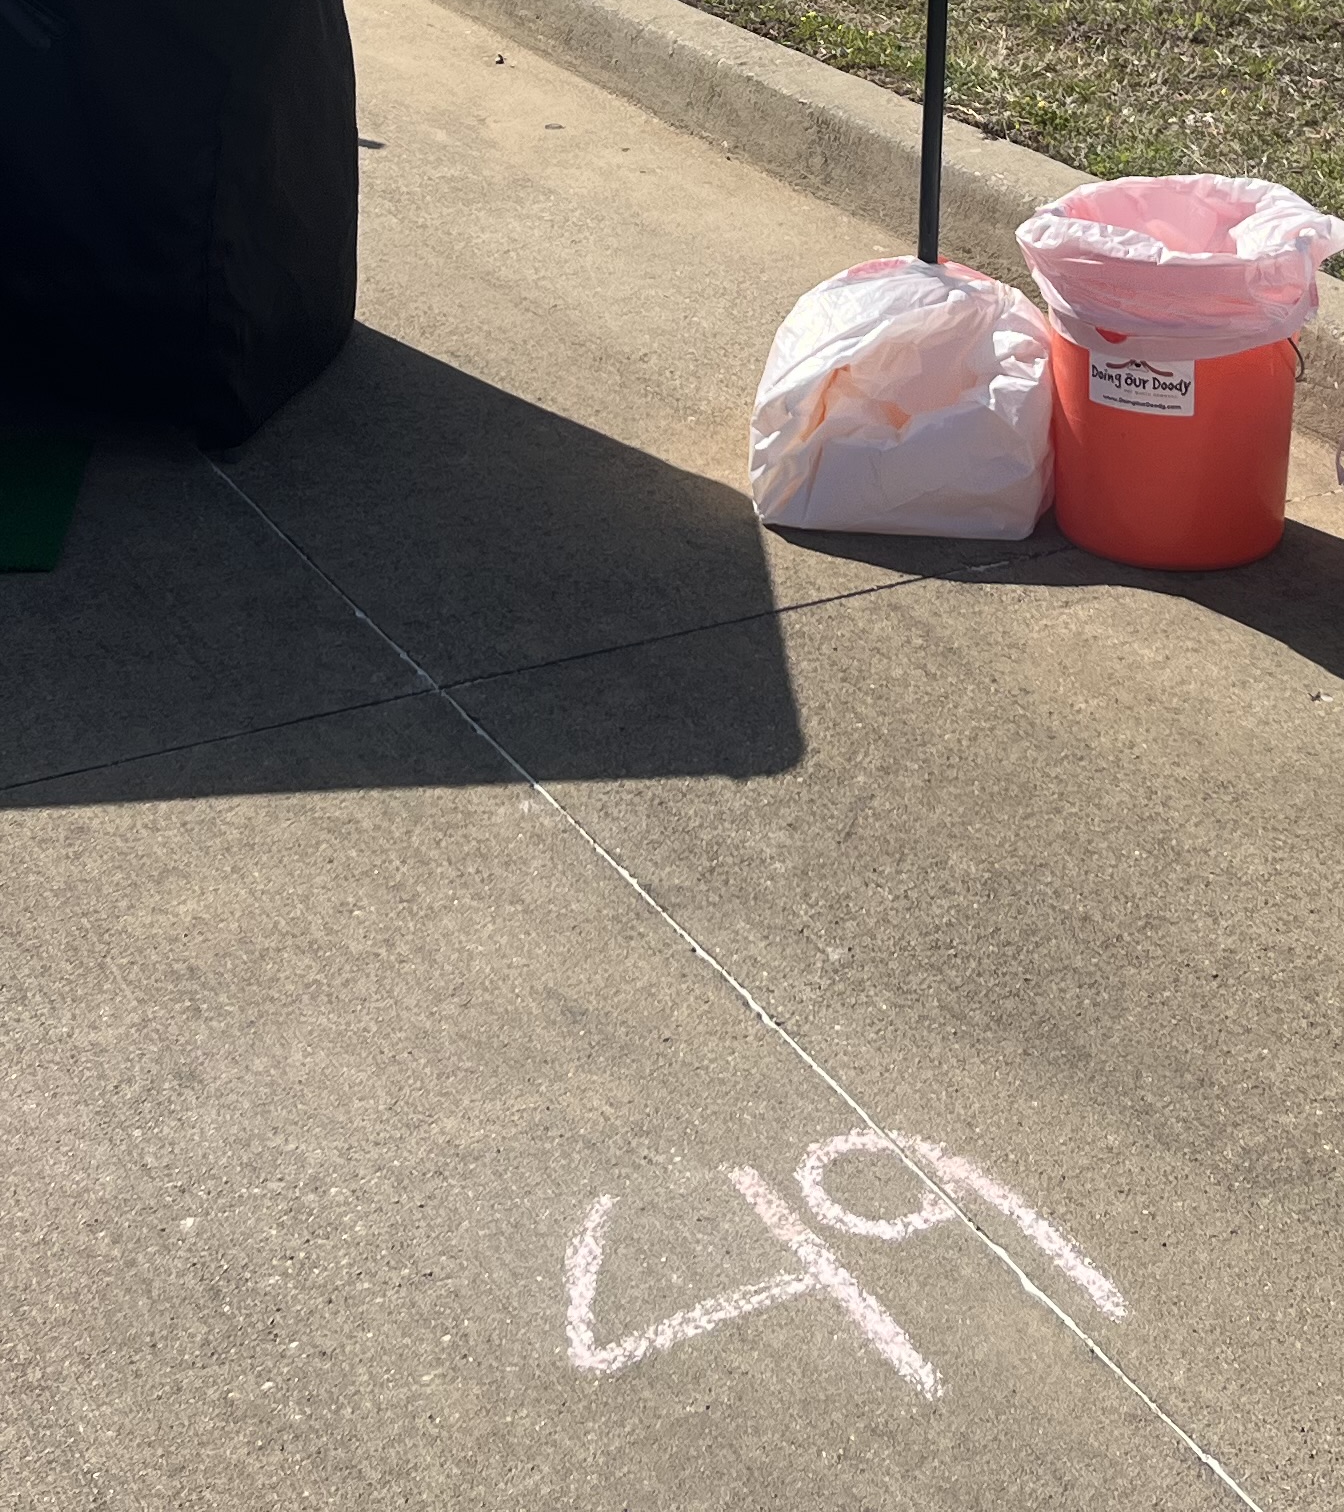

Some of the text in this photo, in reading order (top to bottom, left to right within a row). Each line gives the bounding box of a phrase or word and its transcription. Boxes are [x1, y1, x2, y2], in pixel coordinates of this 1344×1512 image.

[1091, 364, 1122, 389] Doing
[1152, 376, 1192, 397] Doody
[564, 1127, 1131, 1401] 49
